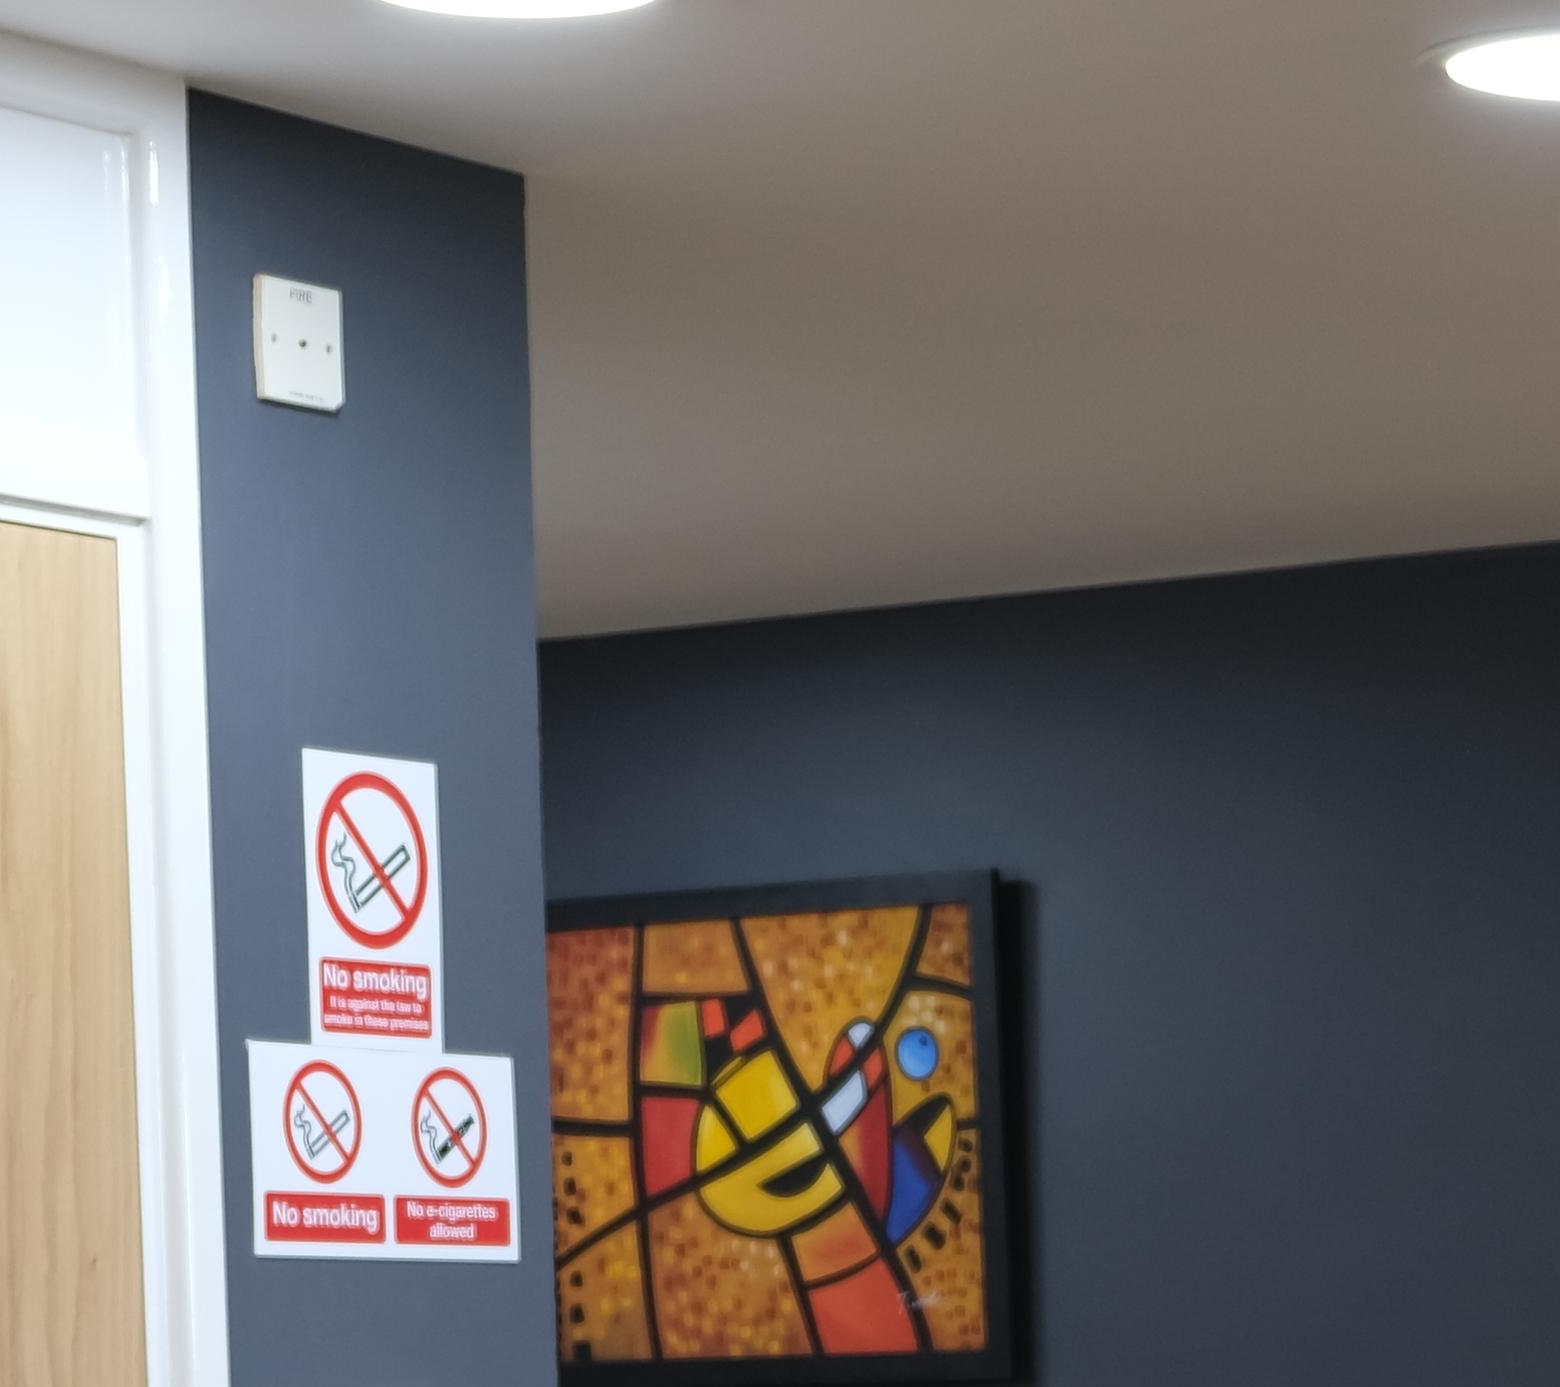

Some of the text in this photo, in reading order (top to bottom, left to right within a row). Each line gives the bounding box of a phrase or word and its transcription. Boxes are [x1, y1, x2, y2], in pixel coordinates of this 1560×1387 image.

[289, 287, 312, 304] FIRE
[323, 963, 427, 1001] No smoking
[272, 1200, 380, 1235] No smoking
[407, 1200, 497, 1221] No e-cigarettes
[429, 1222, 475, 1238] allowed
